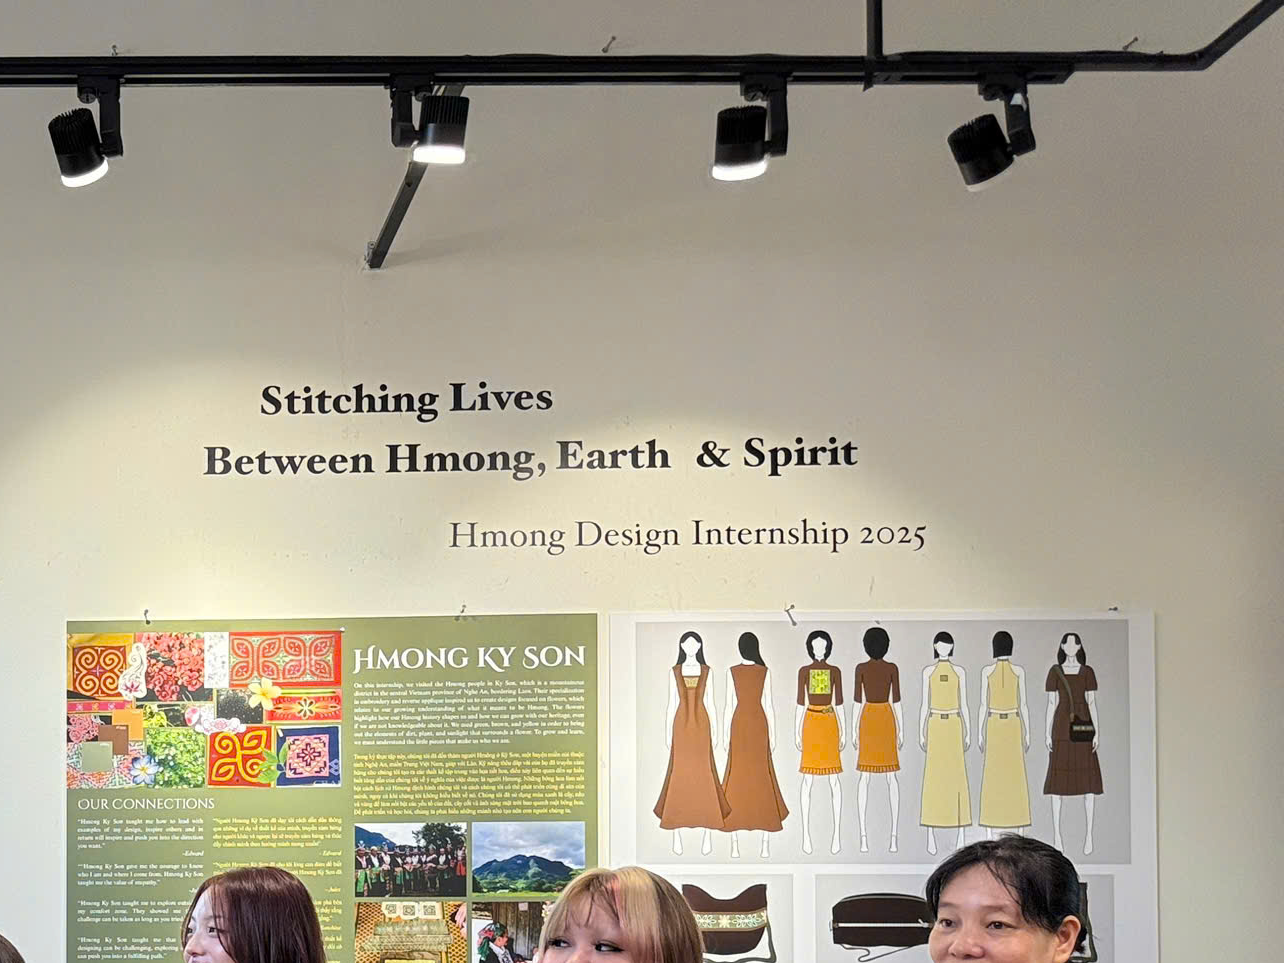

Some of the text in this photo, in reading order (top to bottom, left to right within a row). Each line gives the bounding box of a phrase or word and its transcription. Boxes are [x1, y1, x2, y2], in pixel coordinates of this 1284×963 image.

[260, 380, 553, 424] Stitching Lives
[202, 436, 859, 482] Between Hmong, Earth & Spirit
[448, 517, 927, 556] Hmong Design Internship 2025
[352, 644, 586, 674] HMONG KY SON
[77, 797, 216, 810] OUR CONNECTIONS
